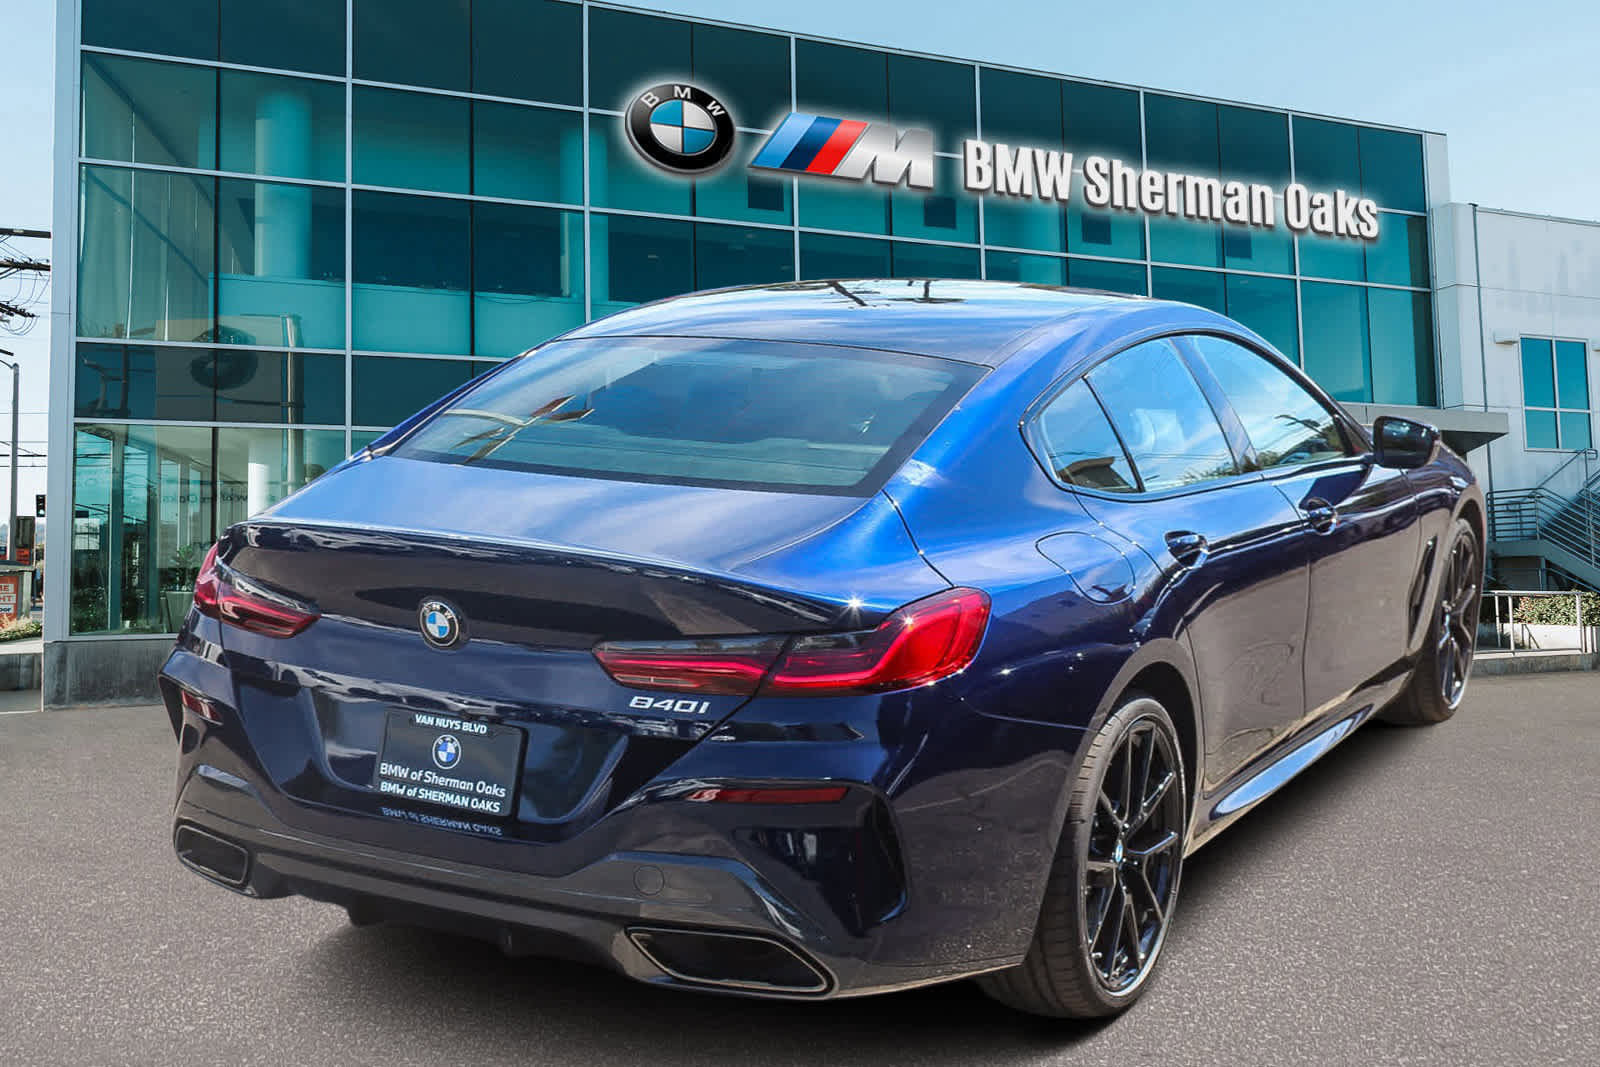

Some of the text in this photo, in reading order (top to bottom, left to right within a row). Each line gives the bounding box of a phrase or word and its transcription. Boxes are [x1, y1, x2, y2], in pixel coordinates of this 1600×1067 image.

[641, 85, 726, 118] BMW
[963, 139, 1379, 241] BMW Sherman Oaks
[415, 714, 488, 735] VAN NUYS BLVD
[380, 763, 507, 798] BMW of Sherman Oaks
[380, 782, 501, 813] BMW of SHERMAN OAKS
